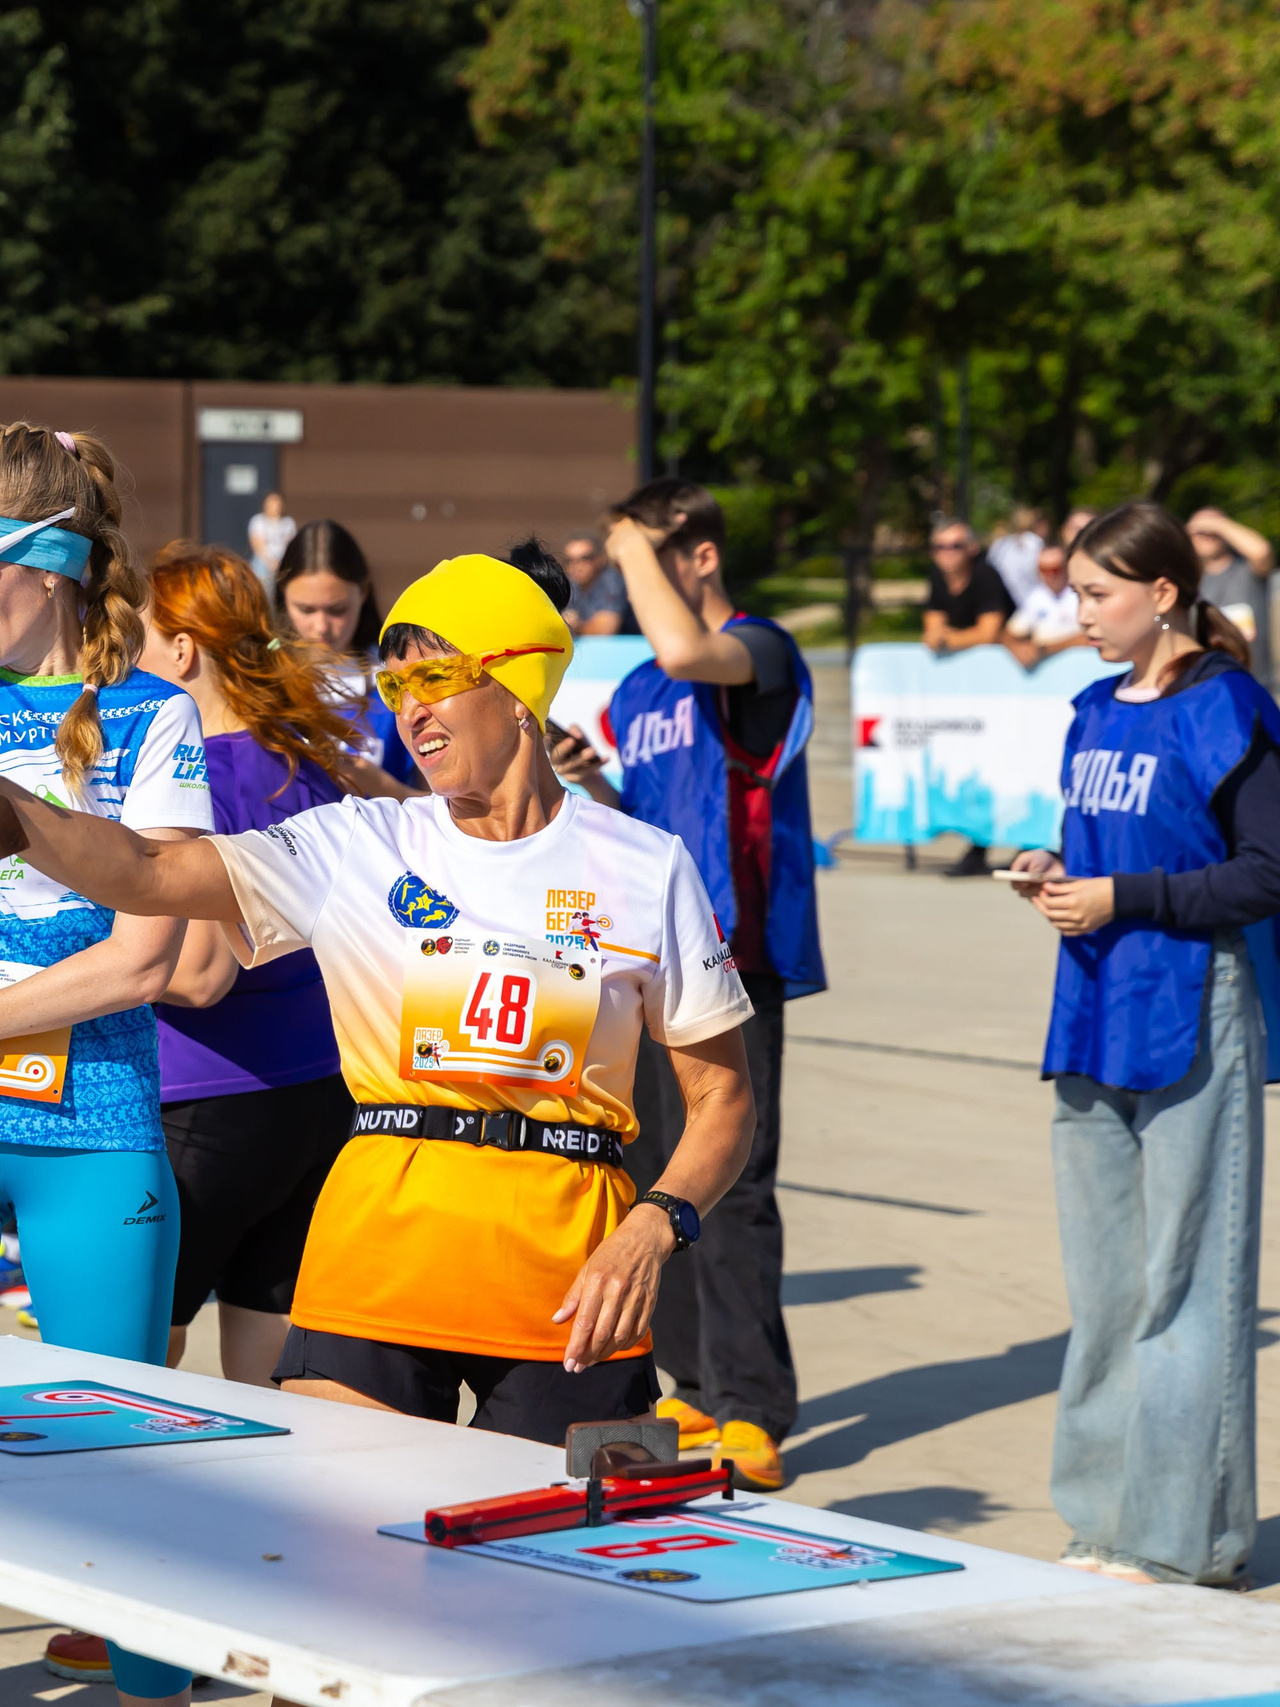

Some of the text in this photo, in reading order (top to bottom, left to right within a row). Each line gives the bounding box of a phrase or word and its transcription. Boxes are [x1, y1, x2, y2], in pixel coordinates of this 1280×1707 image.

[546, 889, 596, 911] ЛАЗЕР
[465, 971, 531, 1045] 48
[123, 1214, 167, 1226] DEMIX
[576, 1533, 737, 1560] 8
